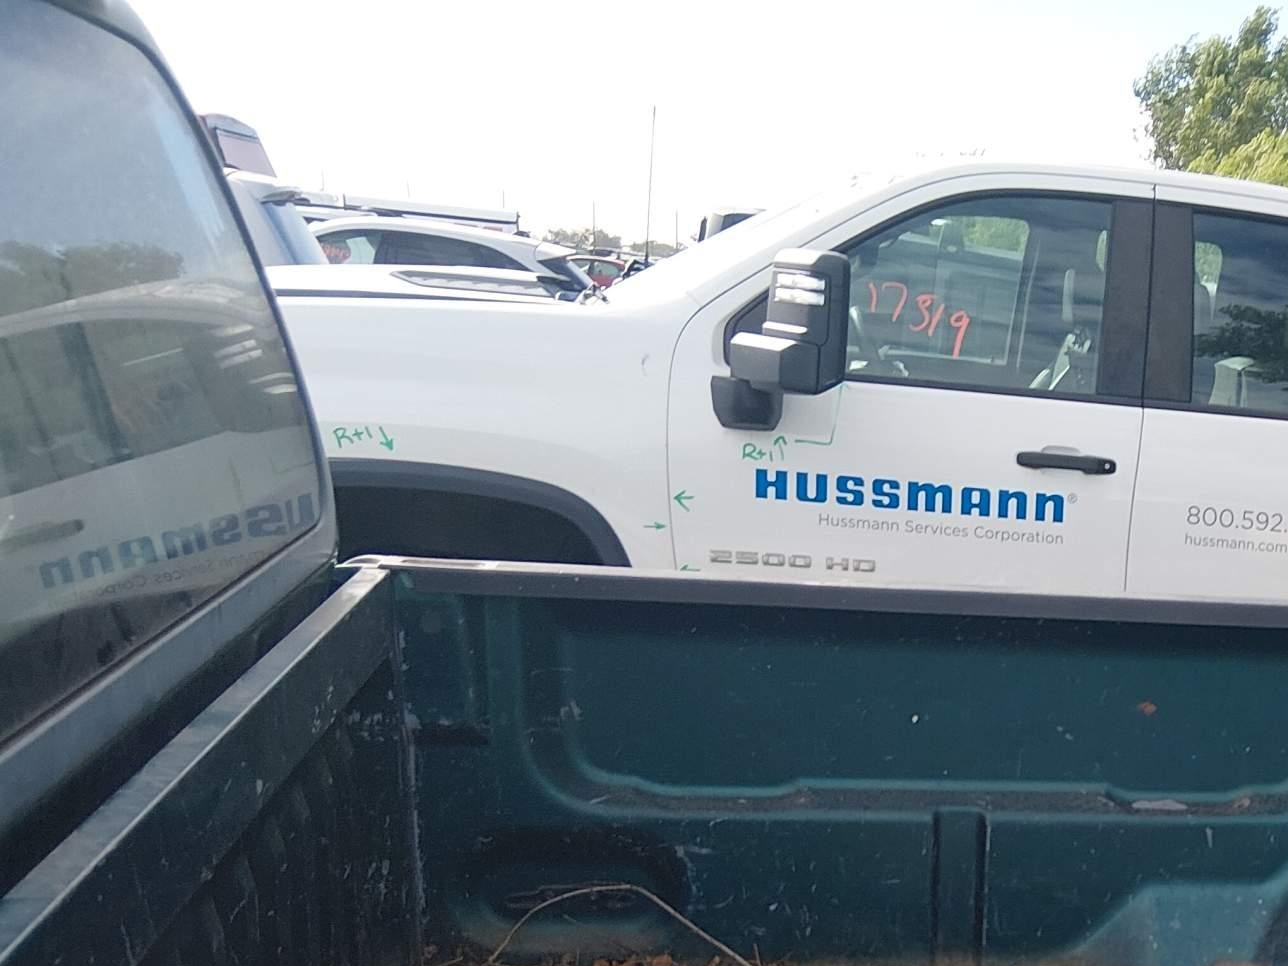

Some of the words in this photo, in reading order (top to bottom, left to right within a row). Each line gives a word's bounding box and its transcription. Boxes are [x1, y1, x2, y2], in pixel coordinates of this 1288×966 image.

[818, 513, 900, 532] Hussmann
[905, 521, 969, 538] Services
[974, 525, 1064, 545] Corporation
[1184, 533, 1288, 553] hussmann.com
[709, 550, 812, 569] 2500
[826, 556, 876, 572] HD
